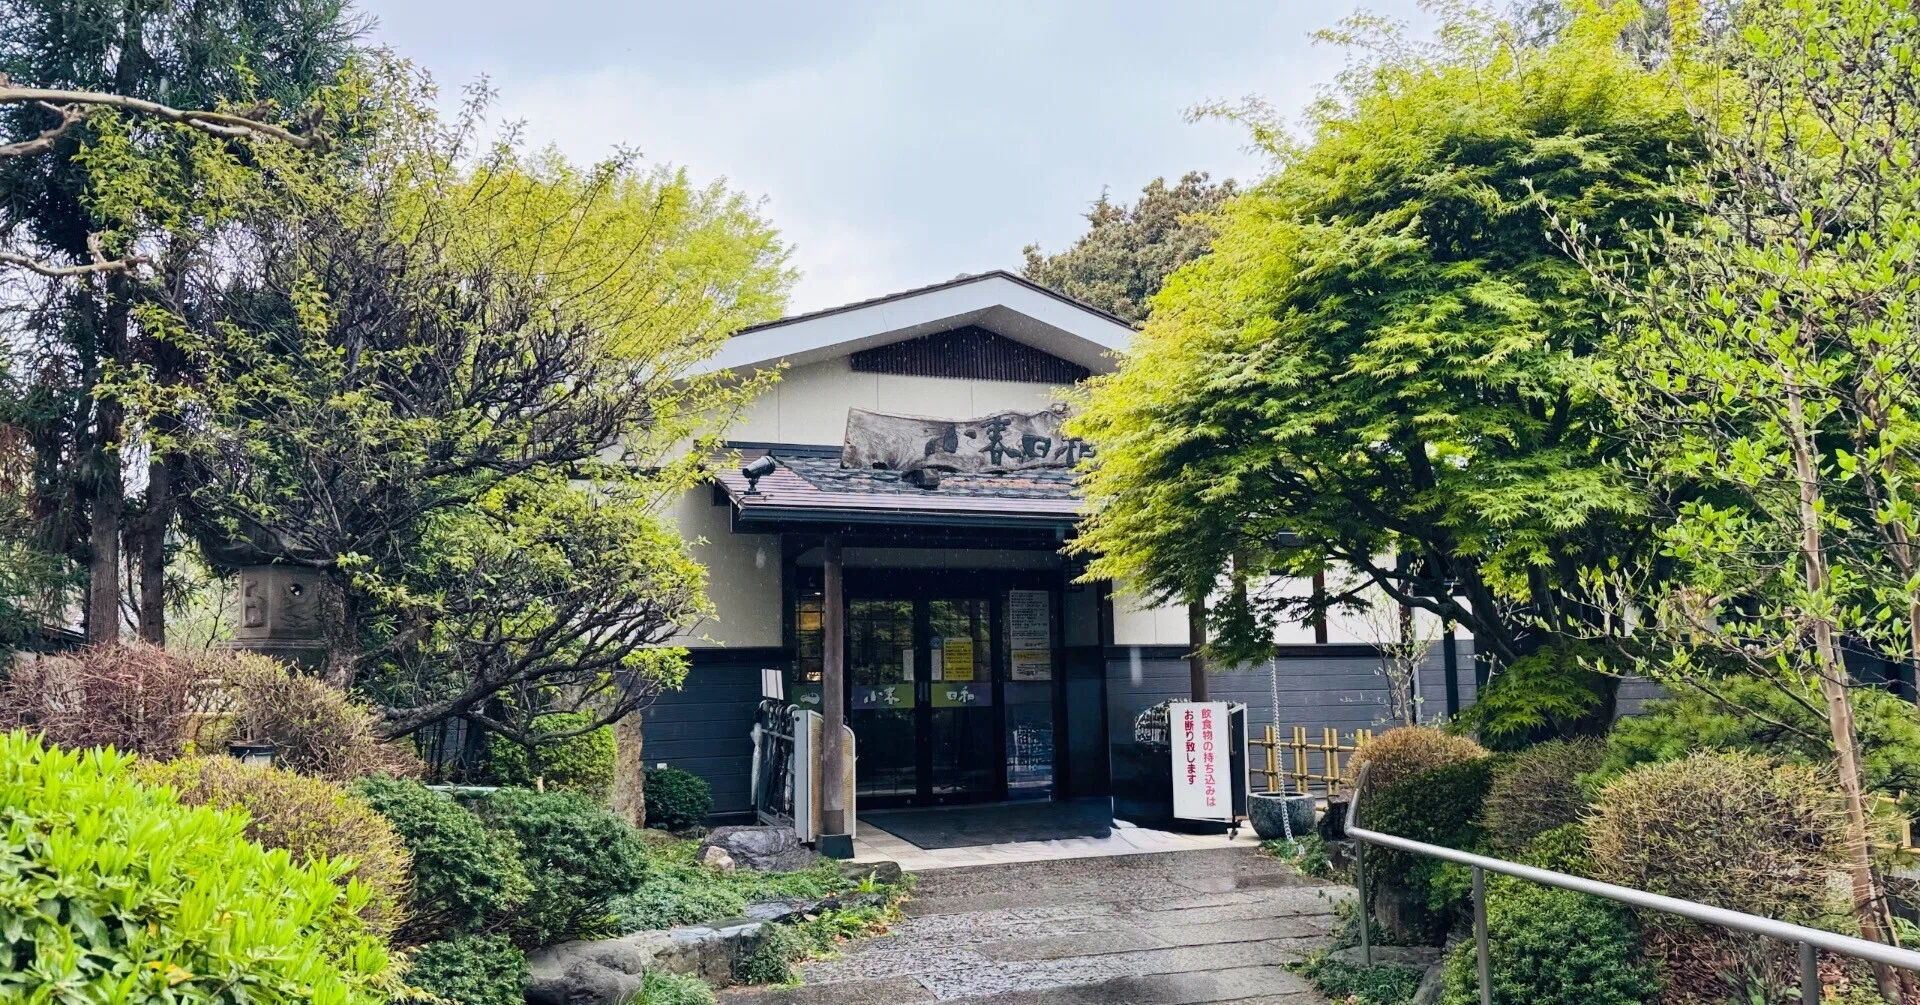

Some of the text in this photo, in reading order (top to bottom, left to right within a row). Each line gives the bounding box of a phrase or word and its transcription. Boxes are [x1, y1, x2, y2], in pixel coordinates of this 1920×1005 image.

[946, 686, 975, 703] 日和
[1184, 710, 1197, 785] お断り致します
[1201, 708, 1216, 807] 飲食物の持ち込みは
